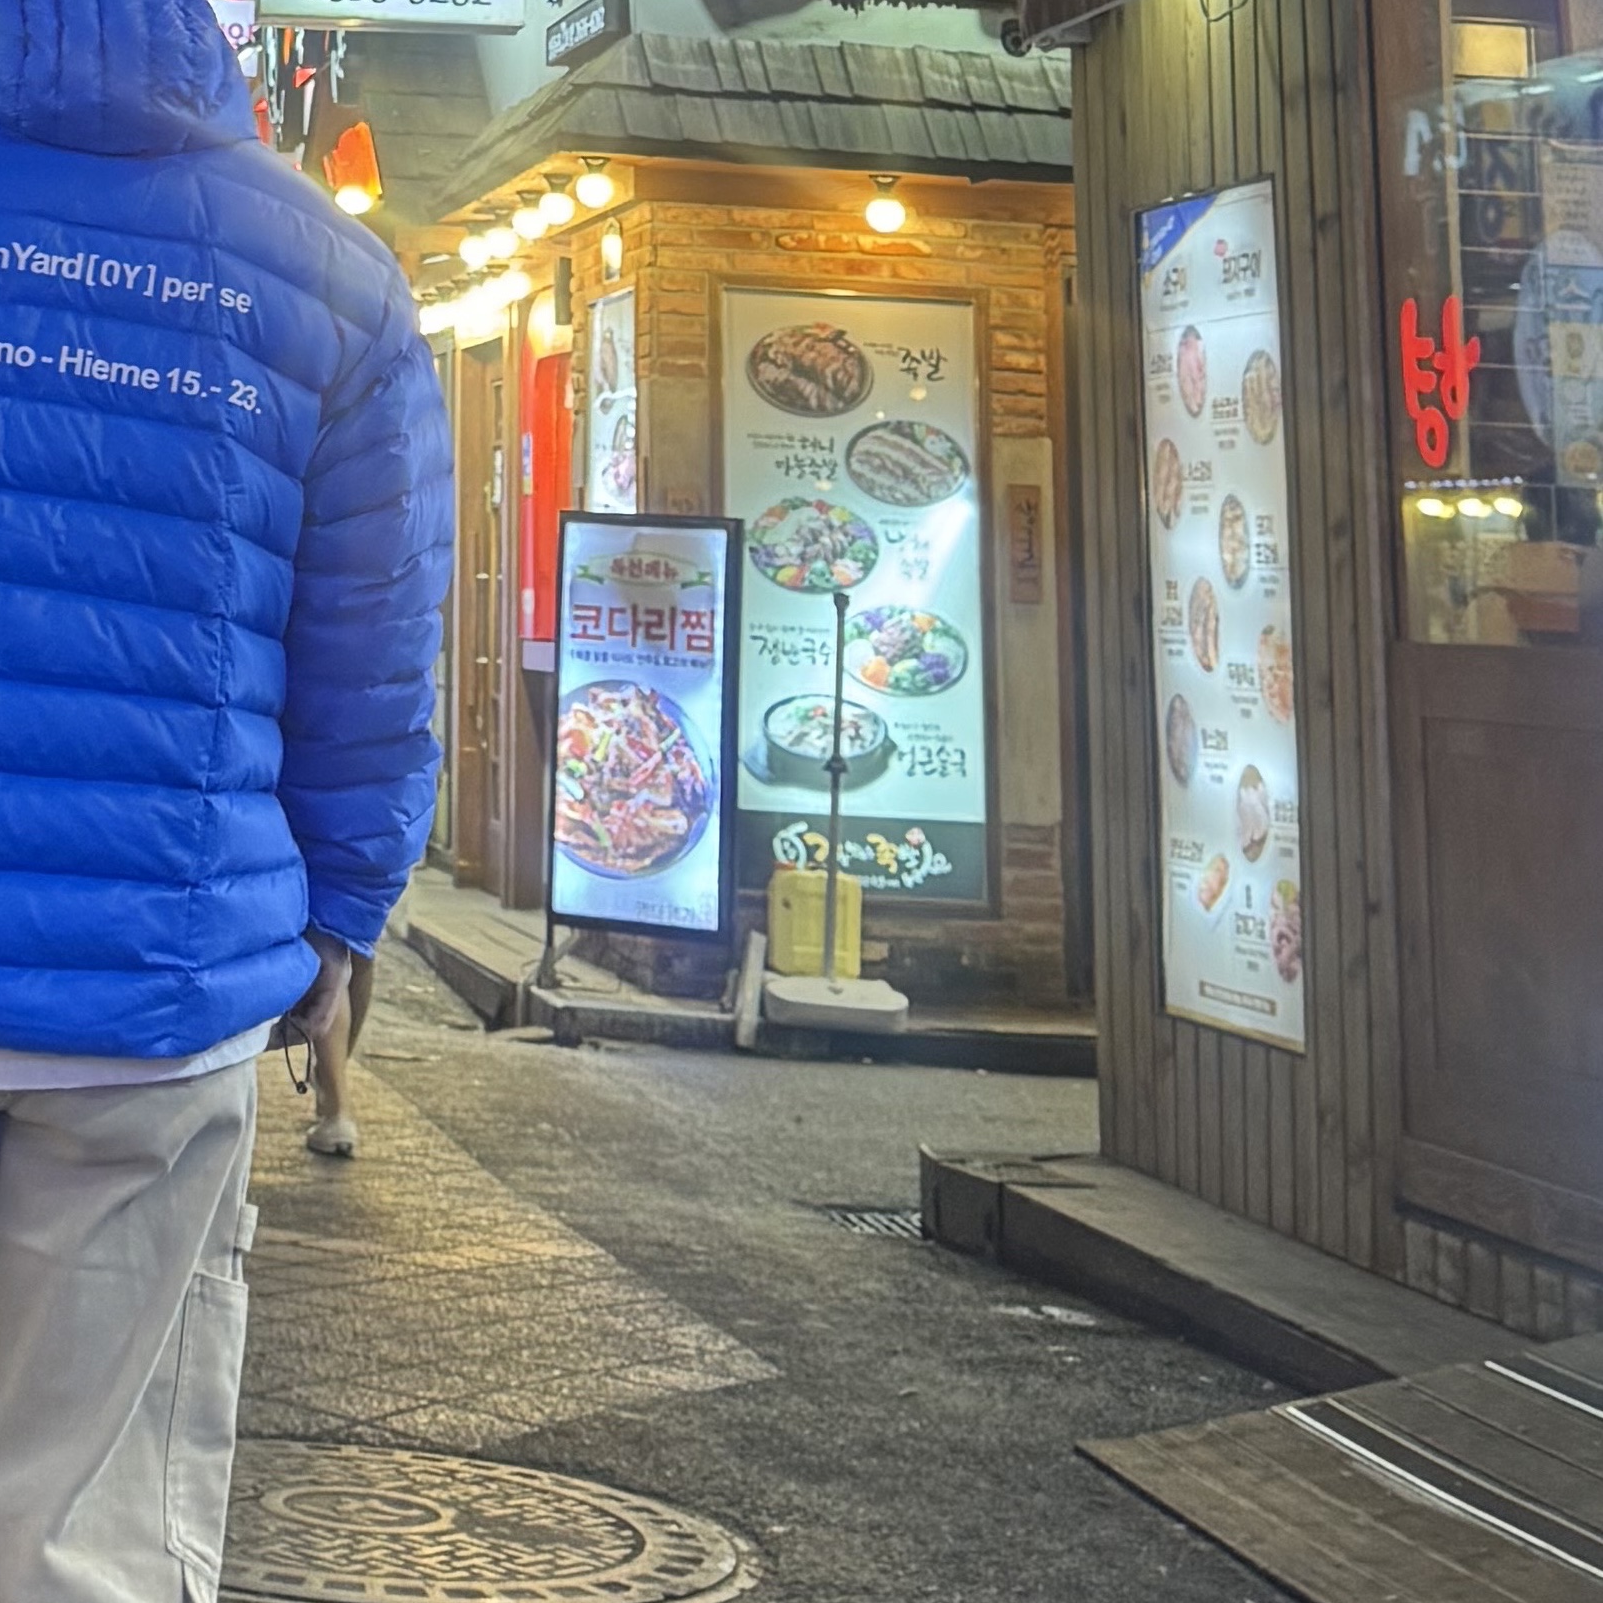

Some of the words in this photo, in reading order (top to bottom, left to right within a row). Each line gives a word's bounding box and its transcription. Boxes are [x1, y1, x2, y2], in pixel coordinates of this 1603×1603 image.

[161, 275, 214, 303] per
[219, 286, 253, 314] se
[58, 344, 161, 390] Hieme
[228, 378, 262, 415] 23.
[898, 346, 949, 383] 족발
[570, 602, 716, 653] 코다리찜
